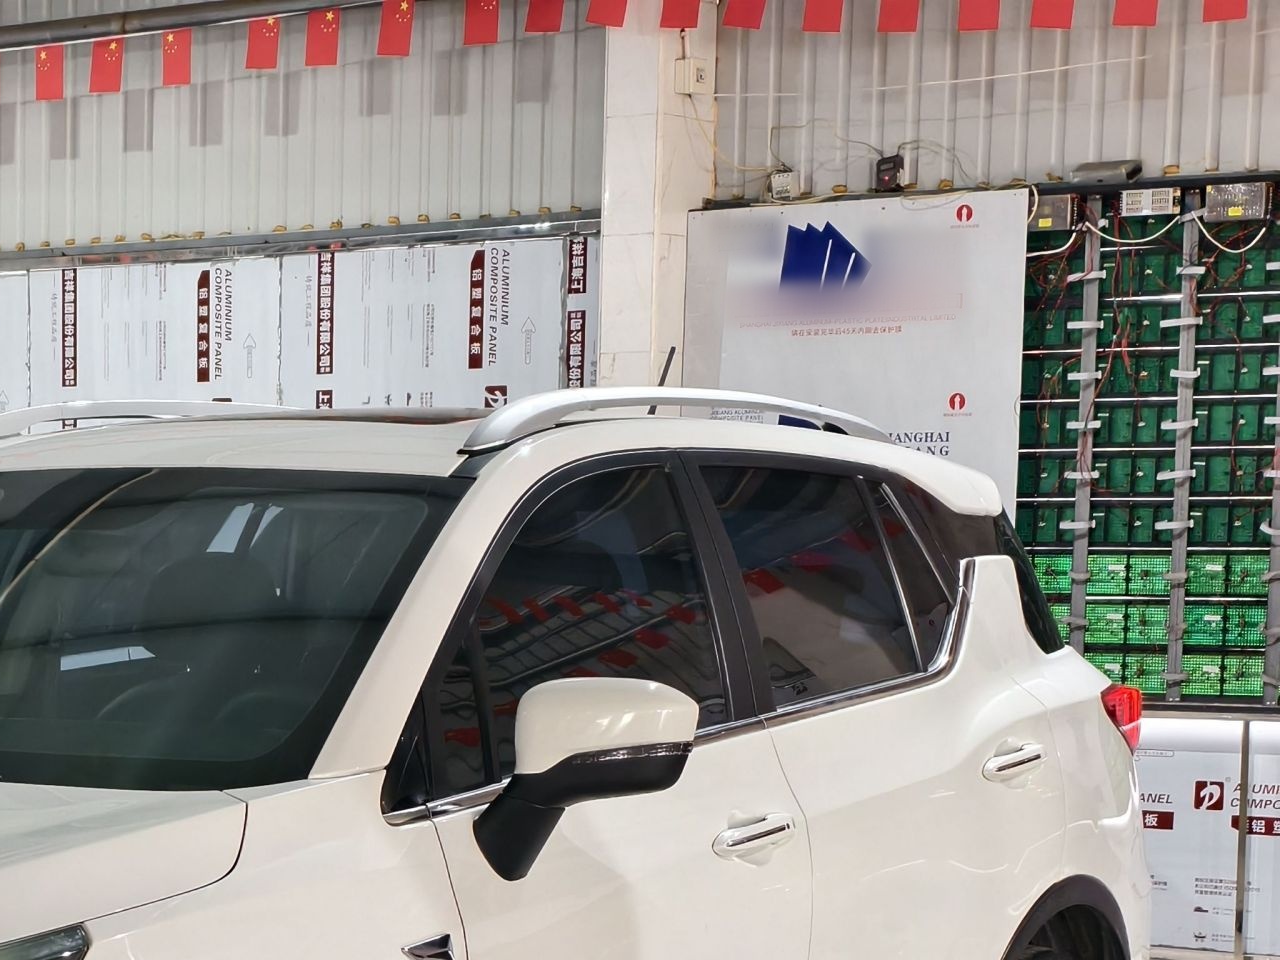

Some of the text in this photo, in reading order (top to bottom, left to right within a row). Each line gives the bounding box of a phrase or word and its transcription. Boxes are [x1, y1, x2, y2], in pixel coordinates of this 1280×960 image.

[214, 267, 223, 381] COMPOSITE PANEL
[224, 269, 233, 342] ALUMINIUM
[470, 268, 483, 355] 铝塑复合板
[488, 247, 499, 367] COMPOSITE PANEL
[500, 248, 510, 326] ALUMINIUM
[1231, 797, 1280, 809] CMPO
